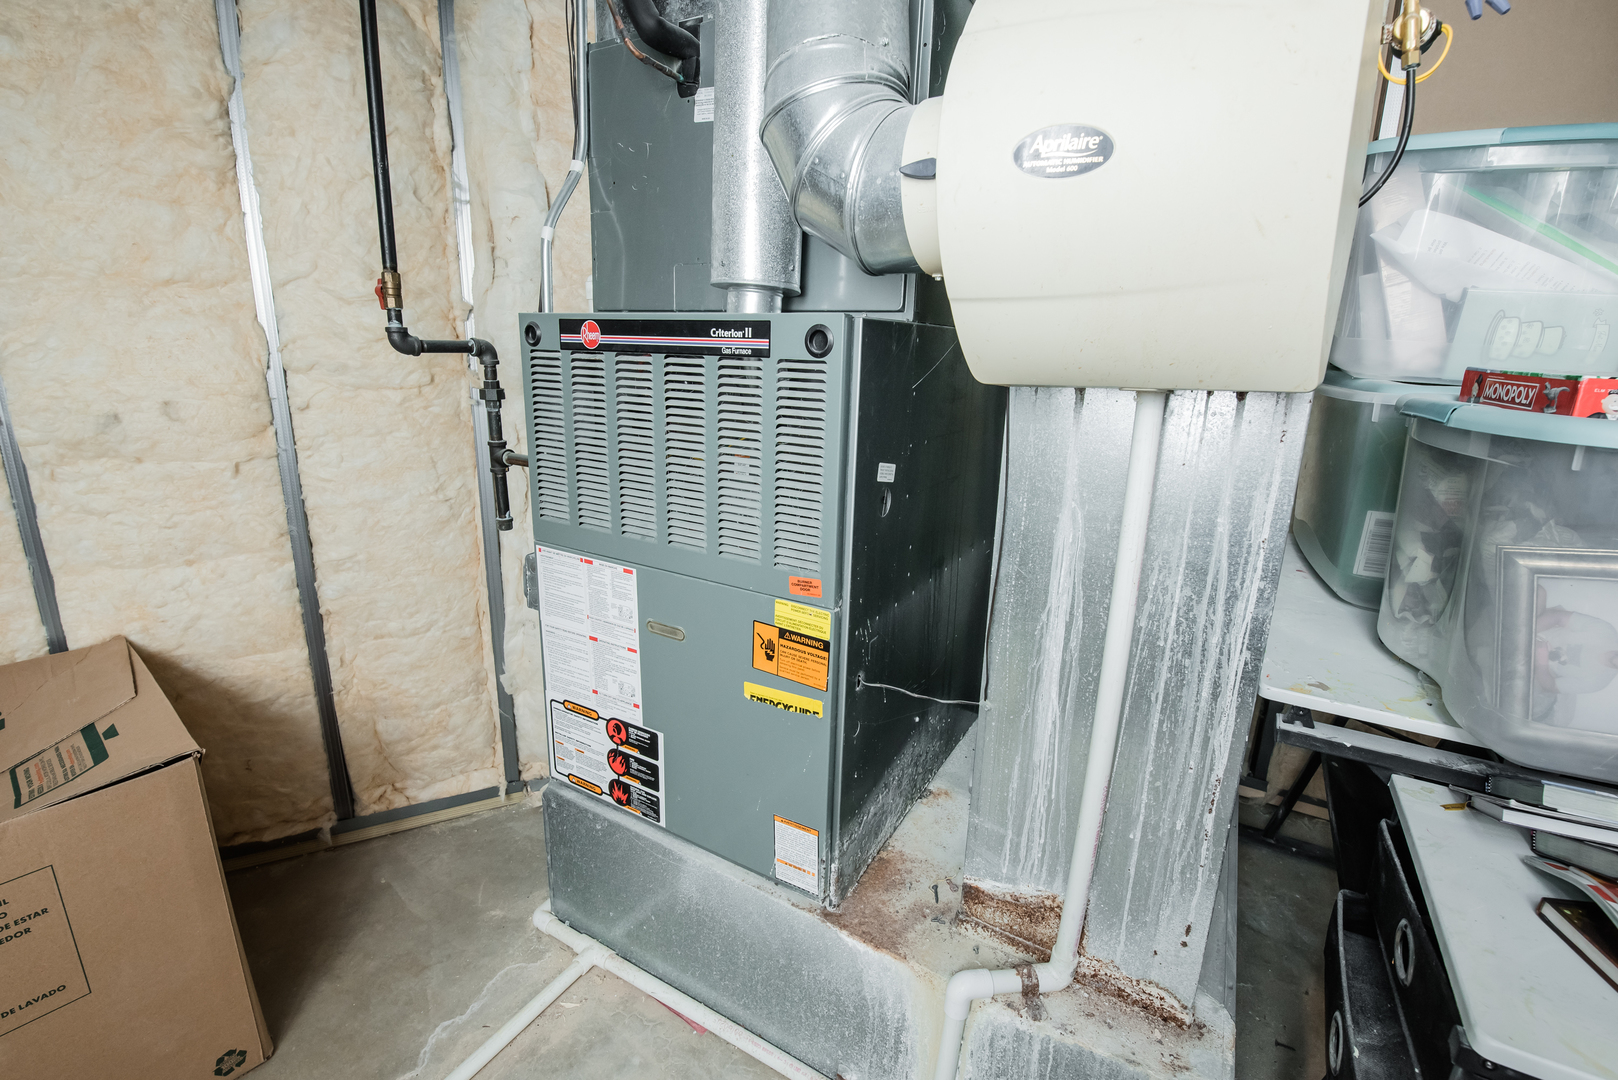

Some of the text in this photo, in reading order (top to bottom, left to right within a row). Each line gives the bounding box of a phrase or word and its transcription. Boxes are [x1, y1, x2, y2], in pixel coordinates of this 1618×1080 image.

[1029, 133, 1100, 157] Aprilaire
[1063, 156, 1104, 165] HUMIDIFIER
[582, 322, 600, 343] Rheem
[710, 328, 743, 338] Criterion
[721, 346, 752, 355] Gas Furnace
[1484, 383, 1536, 404] MONOPOLY
[780, 643, 806, 654] HAZARDOUS
[790, 634, 824, 650] WARNING
[14, 908, 49, 926] ESTAR
[0, 928, 32, 945] EDOR
[0, 984, 66, 1019] DE LAVADO
